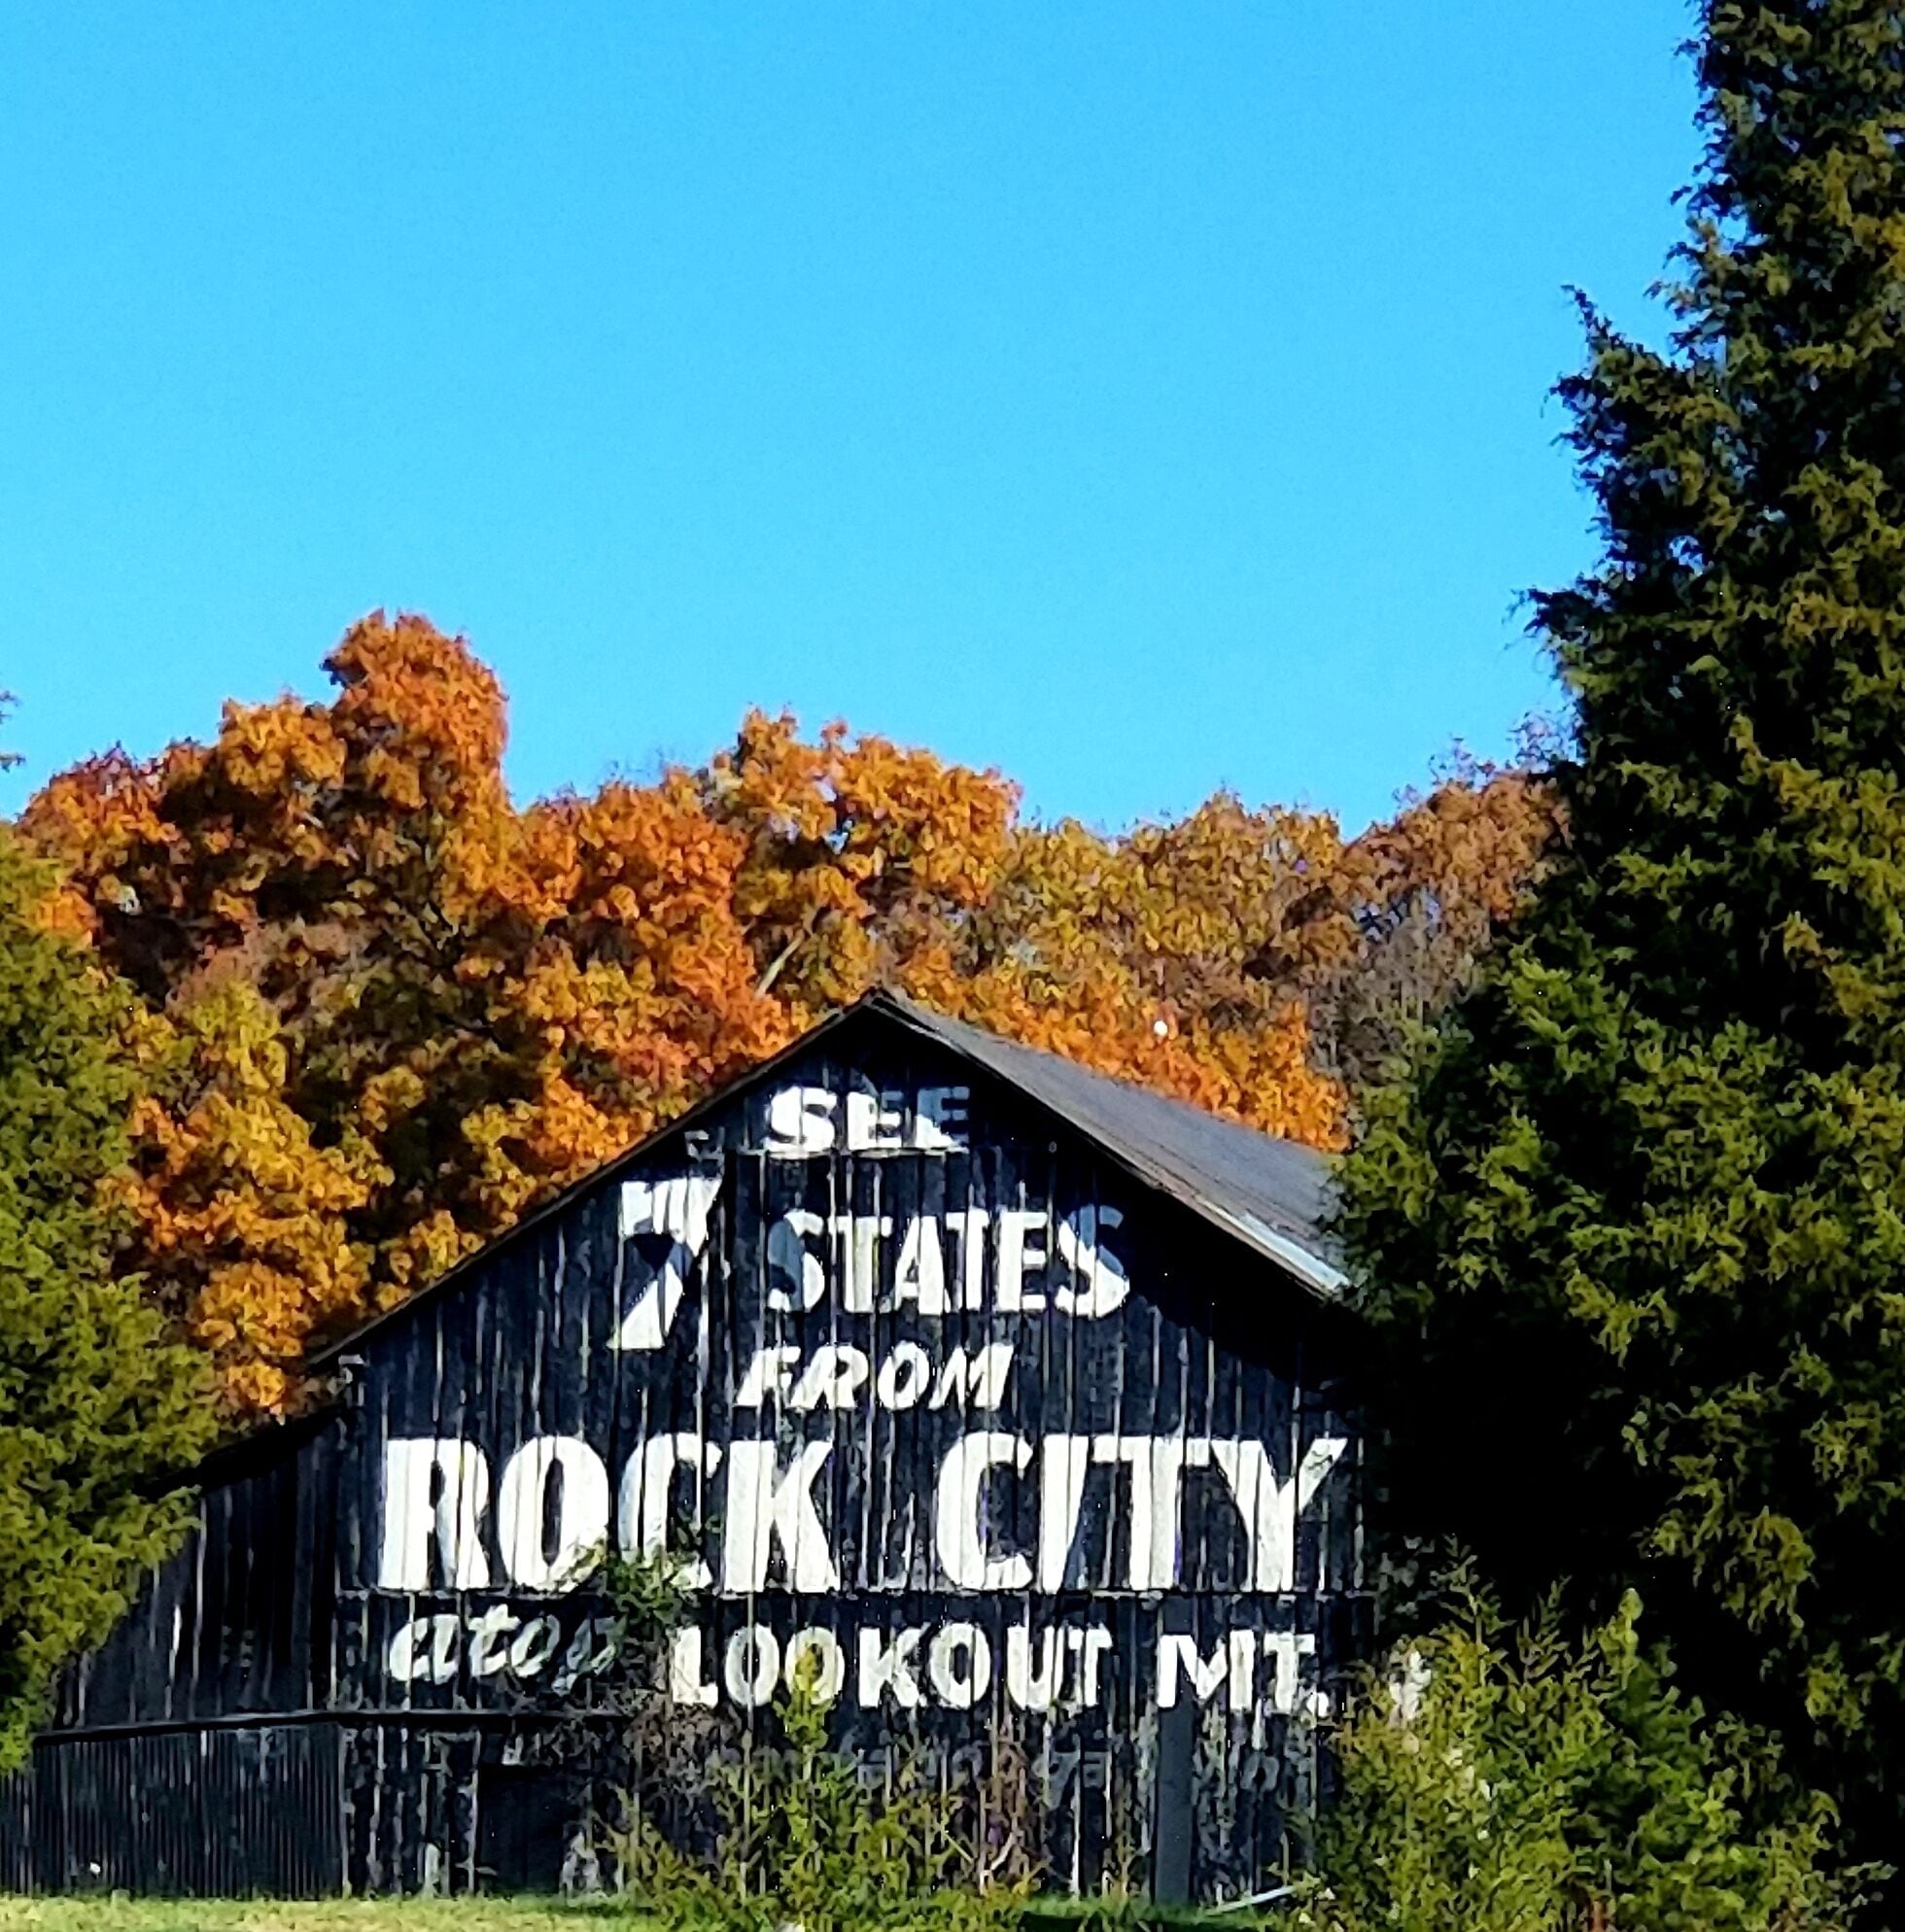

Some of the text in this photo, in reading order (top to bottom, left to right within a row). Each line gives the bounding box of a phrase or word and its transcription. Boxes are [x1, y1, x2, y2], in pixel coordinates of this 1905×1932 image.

[765, 1085, 970, 1157] SEE
[608, 1178, 1130, 1350] 7 STATES
[734, 1340, 1016, 1411] FROM
[378, 1432, 1348, 1594] ROCK CITY
[671, 1621, 1113, 1713] LOOKOUT
[1157, 1629, 1330, 1718] MT.
